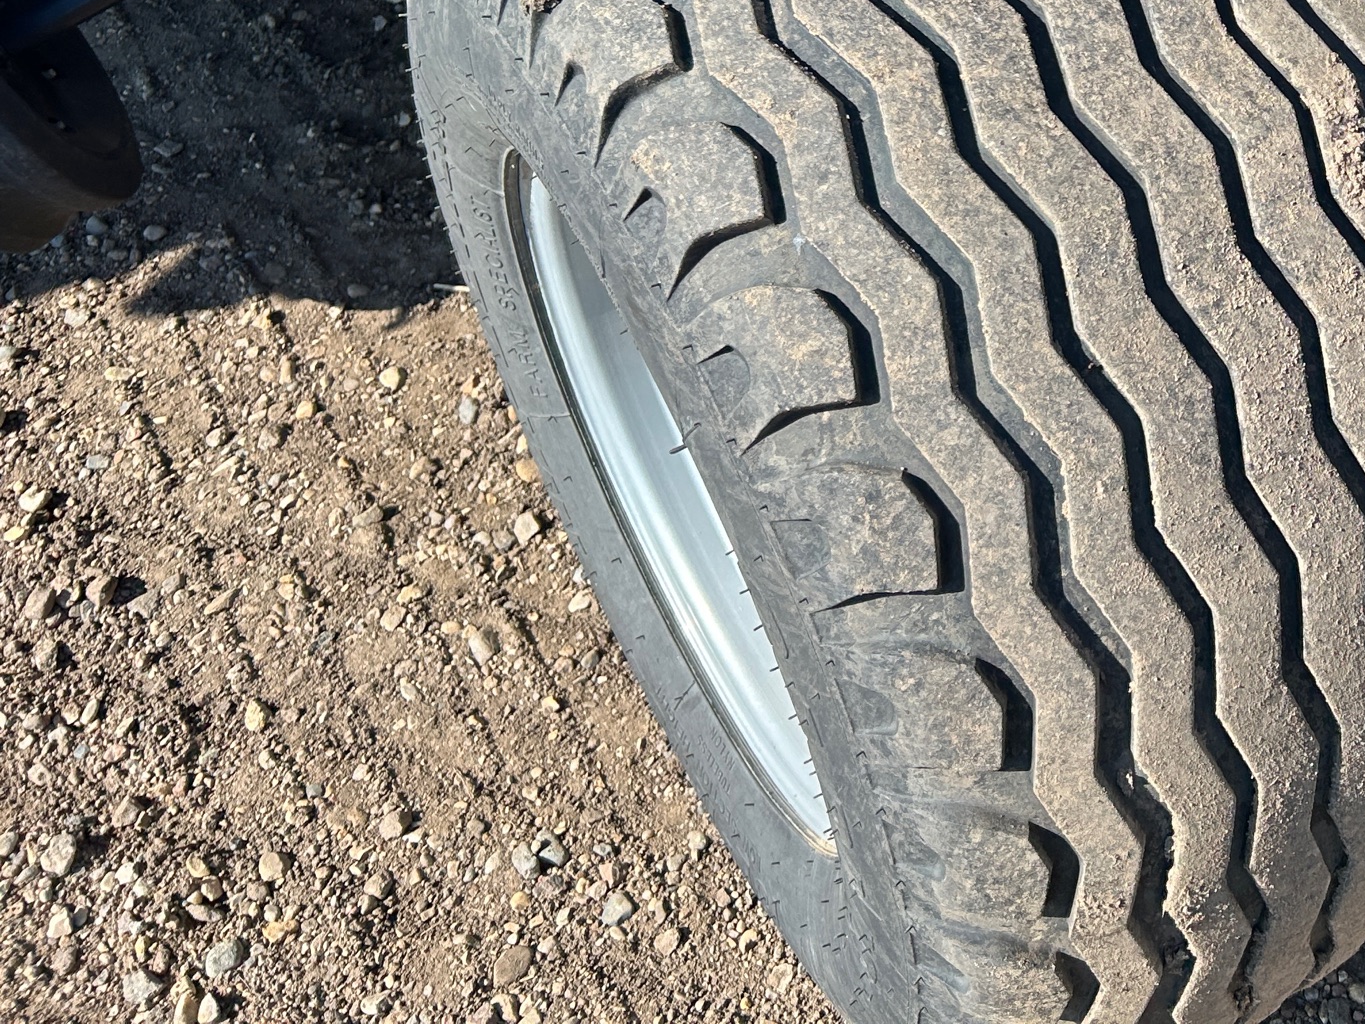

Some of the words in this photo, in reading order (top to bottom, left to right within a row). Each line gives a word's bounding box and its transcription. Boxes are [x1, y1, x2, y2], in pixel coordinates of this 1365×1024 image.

[470, 194, 517, 312] SPECIALIST
[508, 327, 549, 400] FARM
[698, 734, 731, 795] TUBELESS
[711, 726, 736, 772] NYLON
